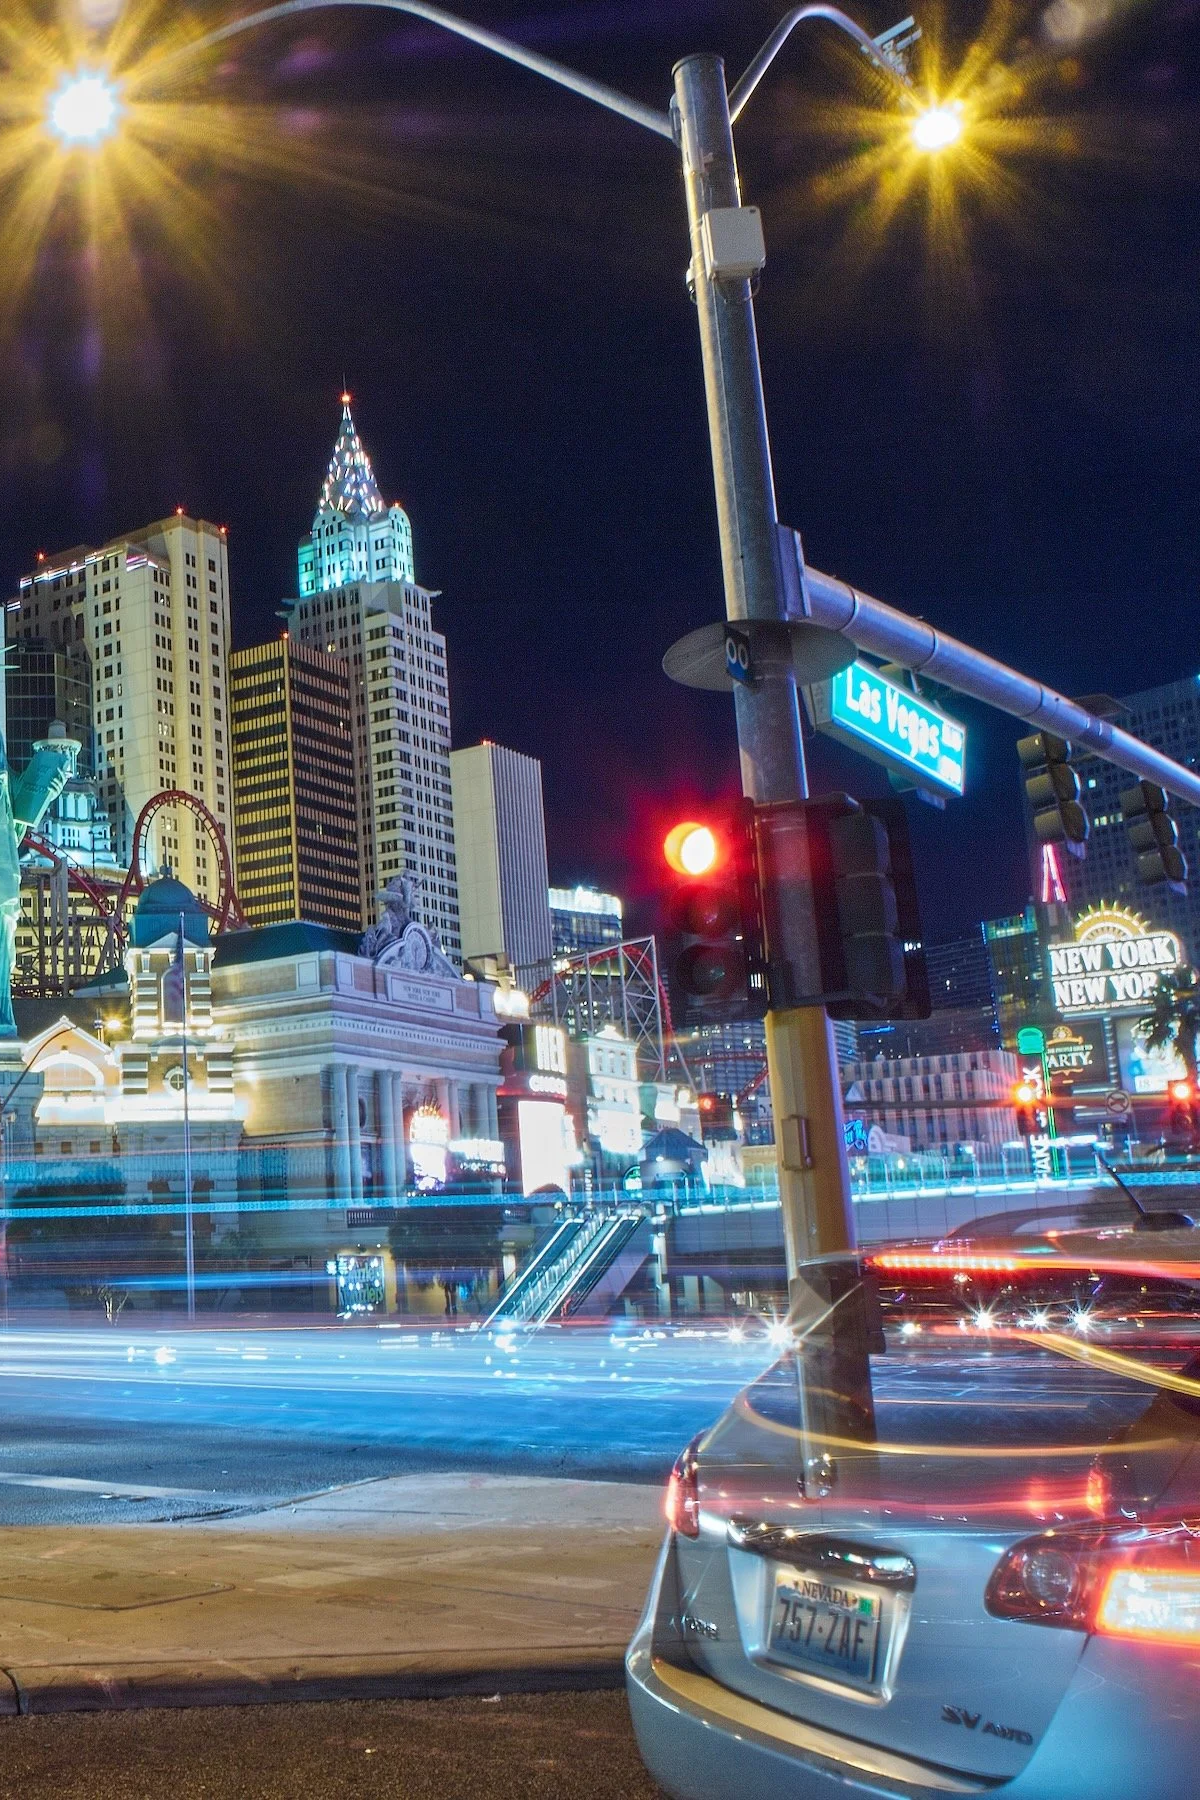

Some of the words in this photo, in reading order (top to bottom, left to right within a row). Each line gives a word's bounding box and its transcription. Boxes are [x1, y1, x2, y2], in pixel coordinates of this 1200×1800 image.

[846, 666, 881, 724] Las
[886, 686, 939, 759] Vegas
[1050, 944, 1103, 976] NEW
[1106, 937, 1175, 969] YORK
[1053, 976, 1106, 1006] NEW
[1110, 971, 1158, 1001] YOR
[1046, 1051, 1093, 1069] ARTY.
[802, 1581, 849, 1608] NEVADA
[941, 1704, 982, 1730] SV
